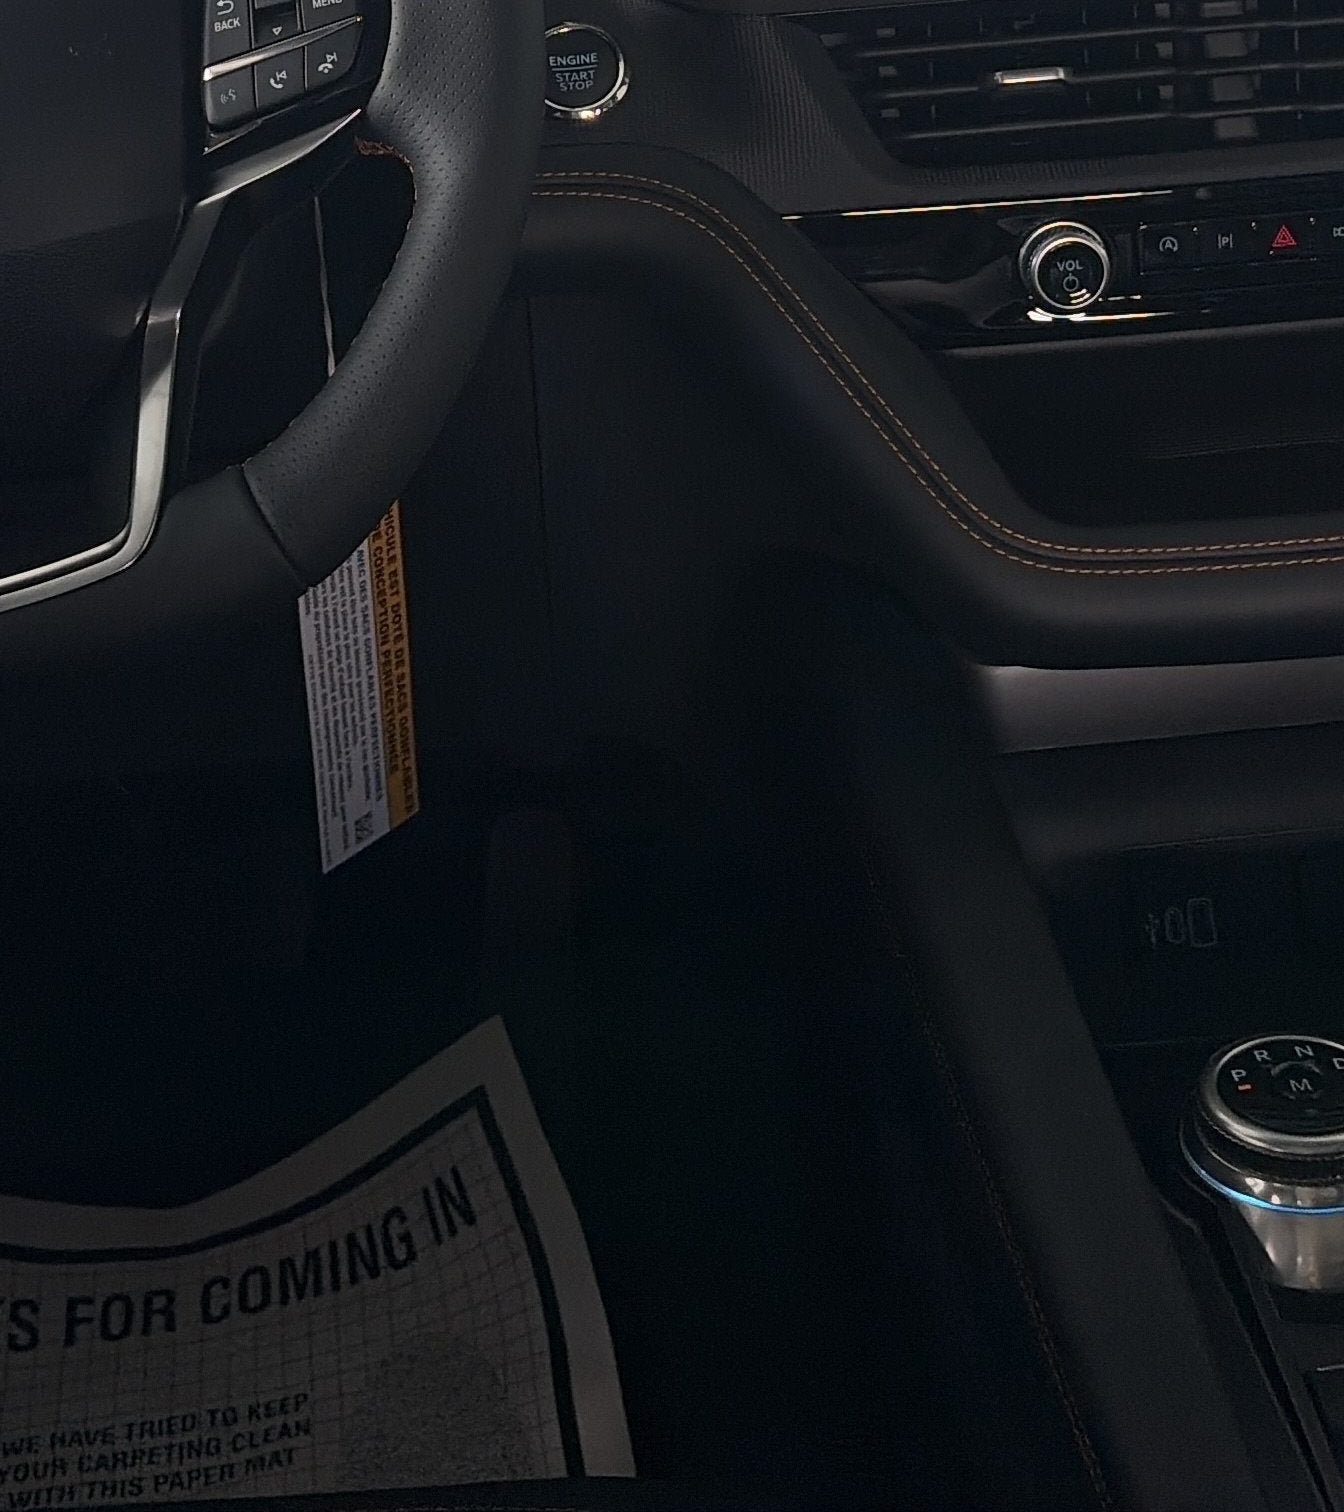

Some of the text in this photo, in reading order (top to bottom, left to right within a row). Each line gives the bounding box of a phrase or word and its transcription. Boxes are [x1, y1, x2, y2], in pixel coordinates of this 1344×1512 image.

[214, 17, 241, 33] BACK
[548, 52, 599, 67] ENGINE
[555, 70, 596, 83] START
[559, 81, 594, 92] STOP
[1057, 259, 1083, 272] VOL
[383, 510, 399, 567] HICULE
[373, 545, 390, 648] CONCEPTION
[387, 568, 401, 597] EST
[394, 648, 406, 671] DE
[1230, 1068, 1247, 1082] P
[1253, 1049, 1273, 1062] R
[1293, 1044, 1315, 1057] N
[1288, 1077, 1313, 1092] M
[63, 1286, 177, 1350] FOR
[200, 1205, 418, 1325] COMING
[419, 1164, 479, 1248] IN
[1, 1392, 309, 1458] WE HAVE TRIED TO KEEP
[78, 1437, 222, 1474] CARPETING
[231, 1418, 312, 1453] CLEAN
[8, 1447, 296, 1509] WITH THIS PAPER MAT
